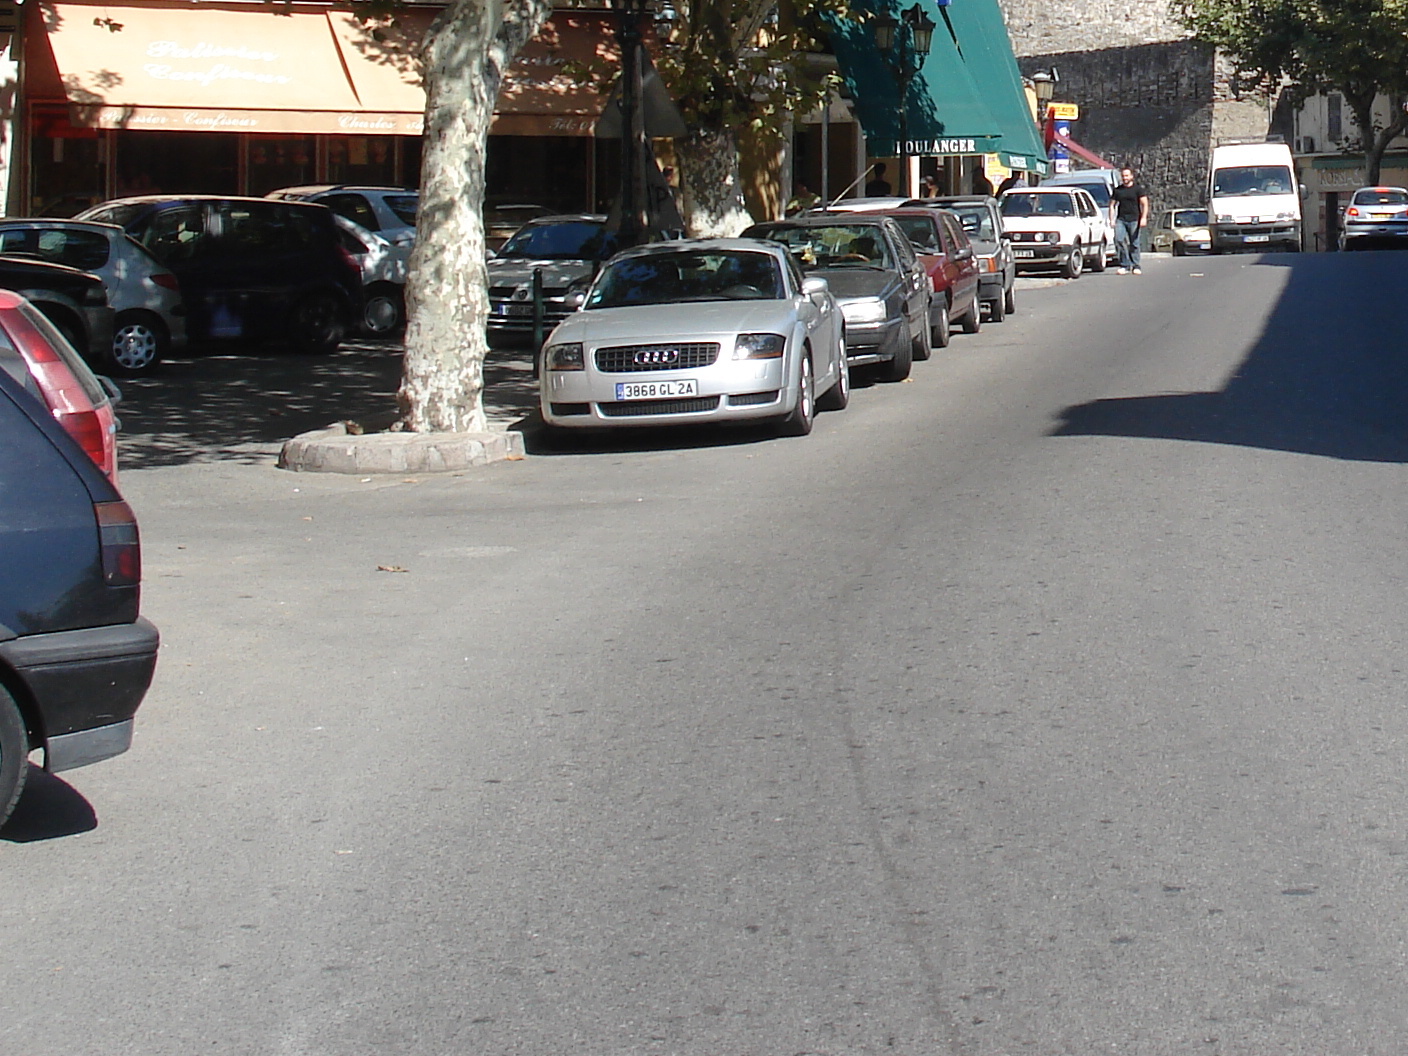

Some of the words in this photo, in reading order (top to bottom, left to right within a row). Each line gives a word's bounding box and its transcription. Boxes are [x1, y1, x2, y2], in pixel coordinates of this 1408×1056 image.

[625, 384, 656, 398] 3868
[660, 383, 675, 396] GL
[677, 382, 693, 395] 2A
